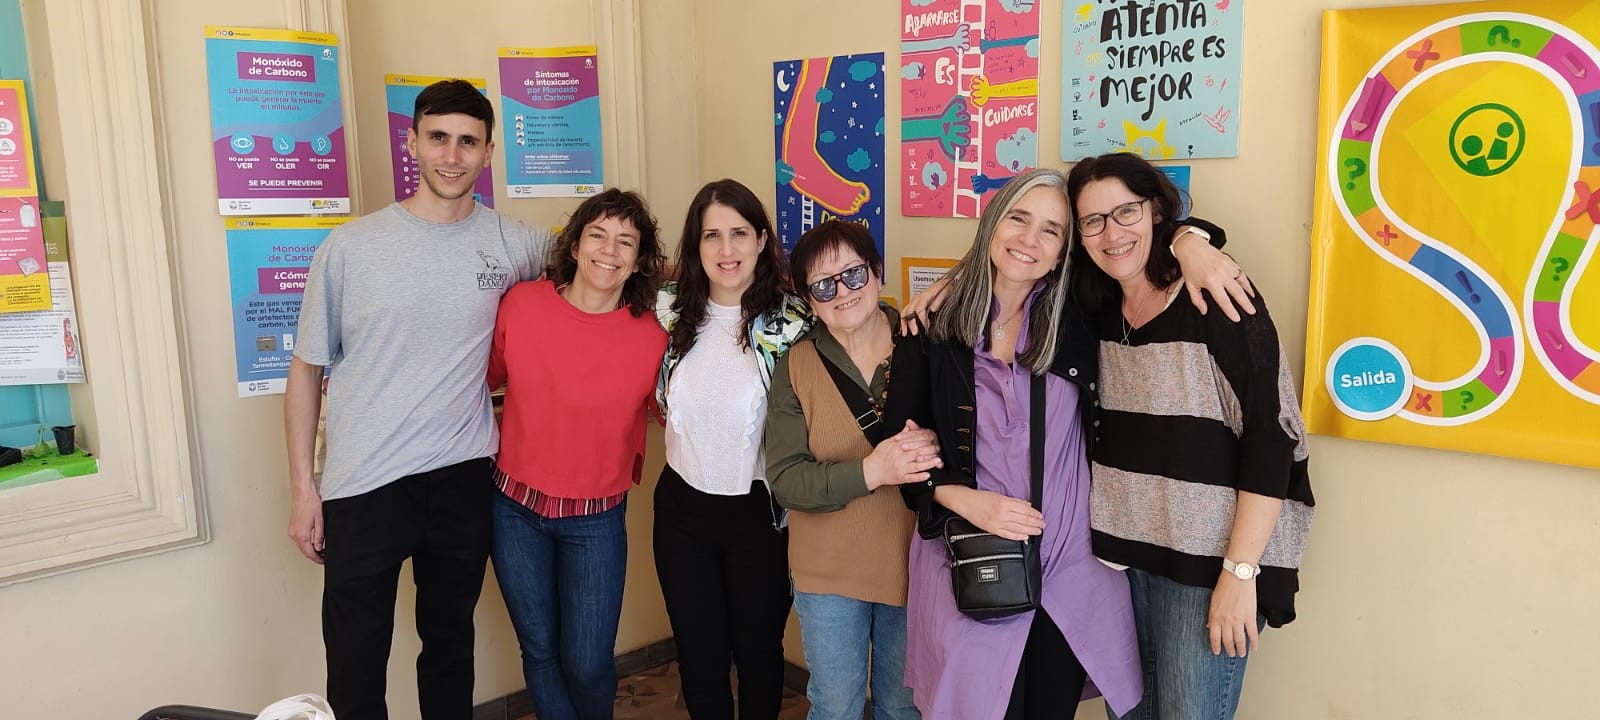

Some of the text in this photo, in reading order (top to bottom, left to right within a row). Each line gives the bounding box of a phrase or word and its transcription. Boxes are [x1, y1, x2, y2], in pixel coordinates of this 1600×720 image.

[1100, 0, 1207, 43] ATENTA
[1202, 35, 1226, 58] ES
[252, 56, 303, 68] Monóxido
[248, 66, 307, 78] de Carbono
[535, 70, 570, 78] Síntomas
[524, 77, 580, 86] de intoxicación
[239, 87, 284, 95] intoxicación
[285, 89, 298, 97] por
[527, 87, 541, 95] por
[543, 93, 574, 101] Carbono
[268, 254, 281, 262] de
[1340, 370, 1396, 388] Salida
